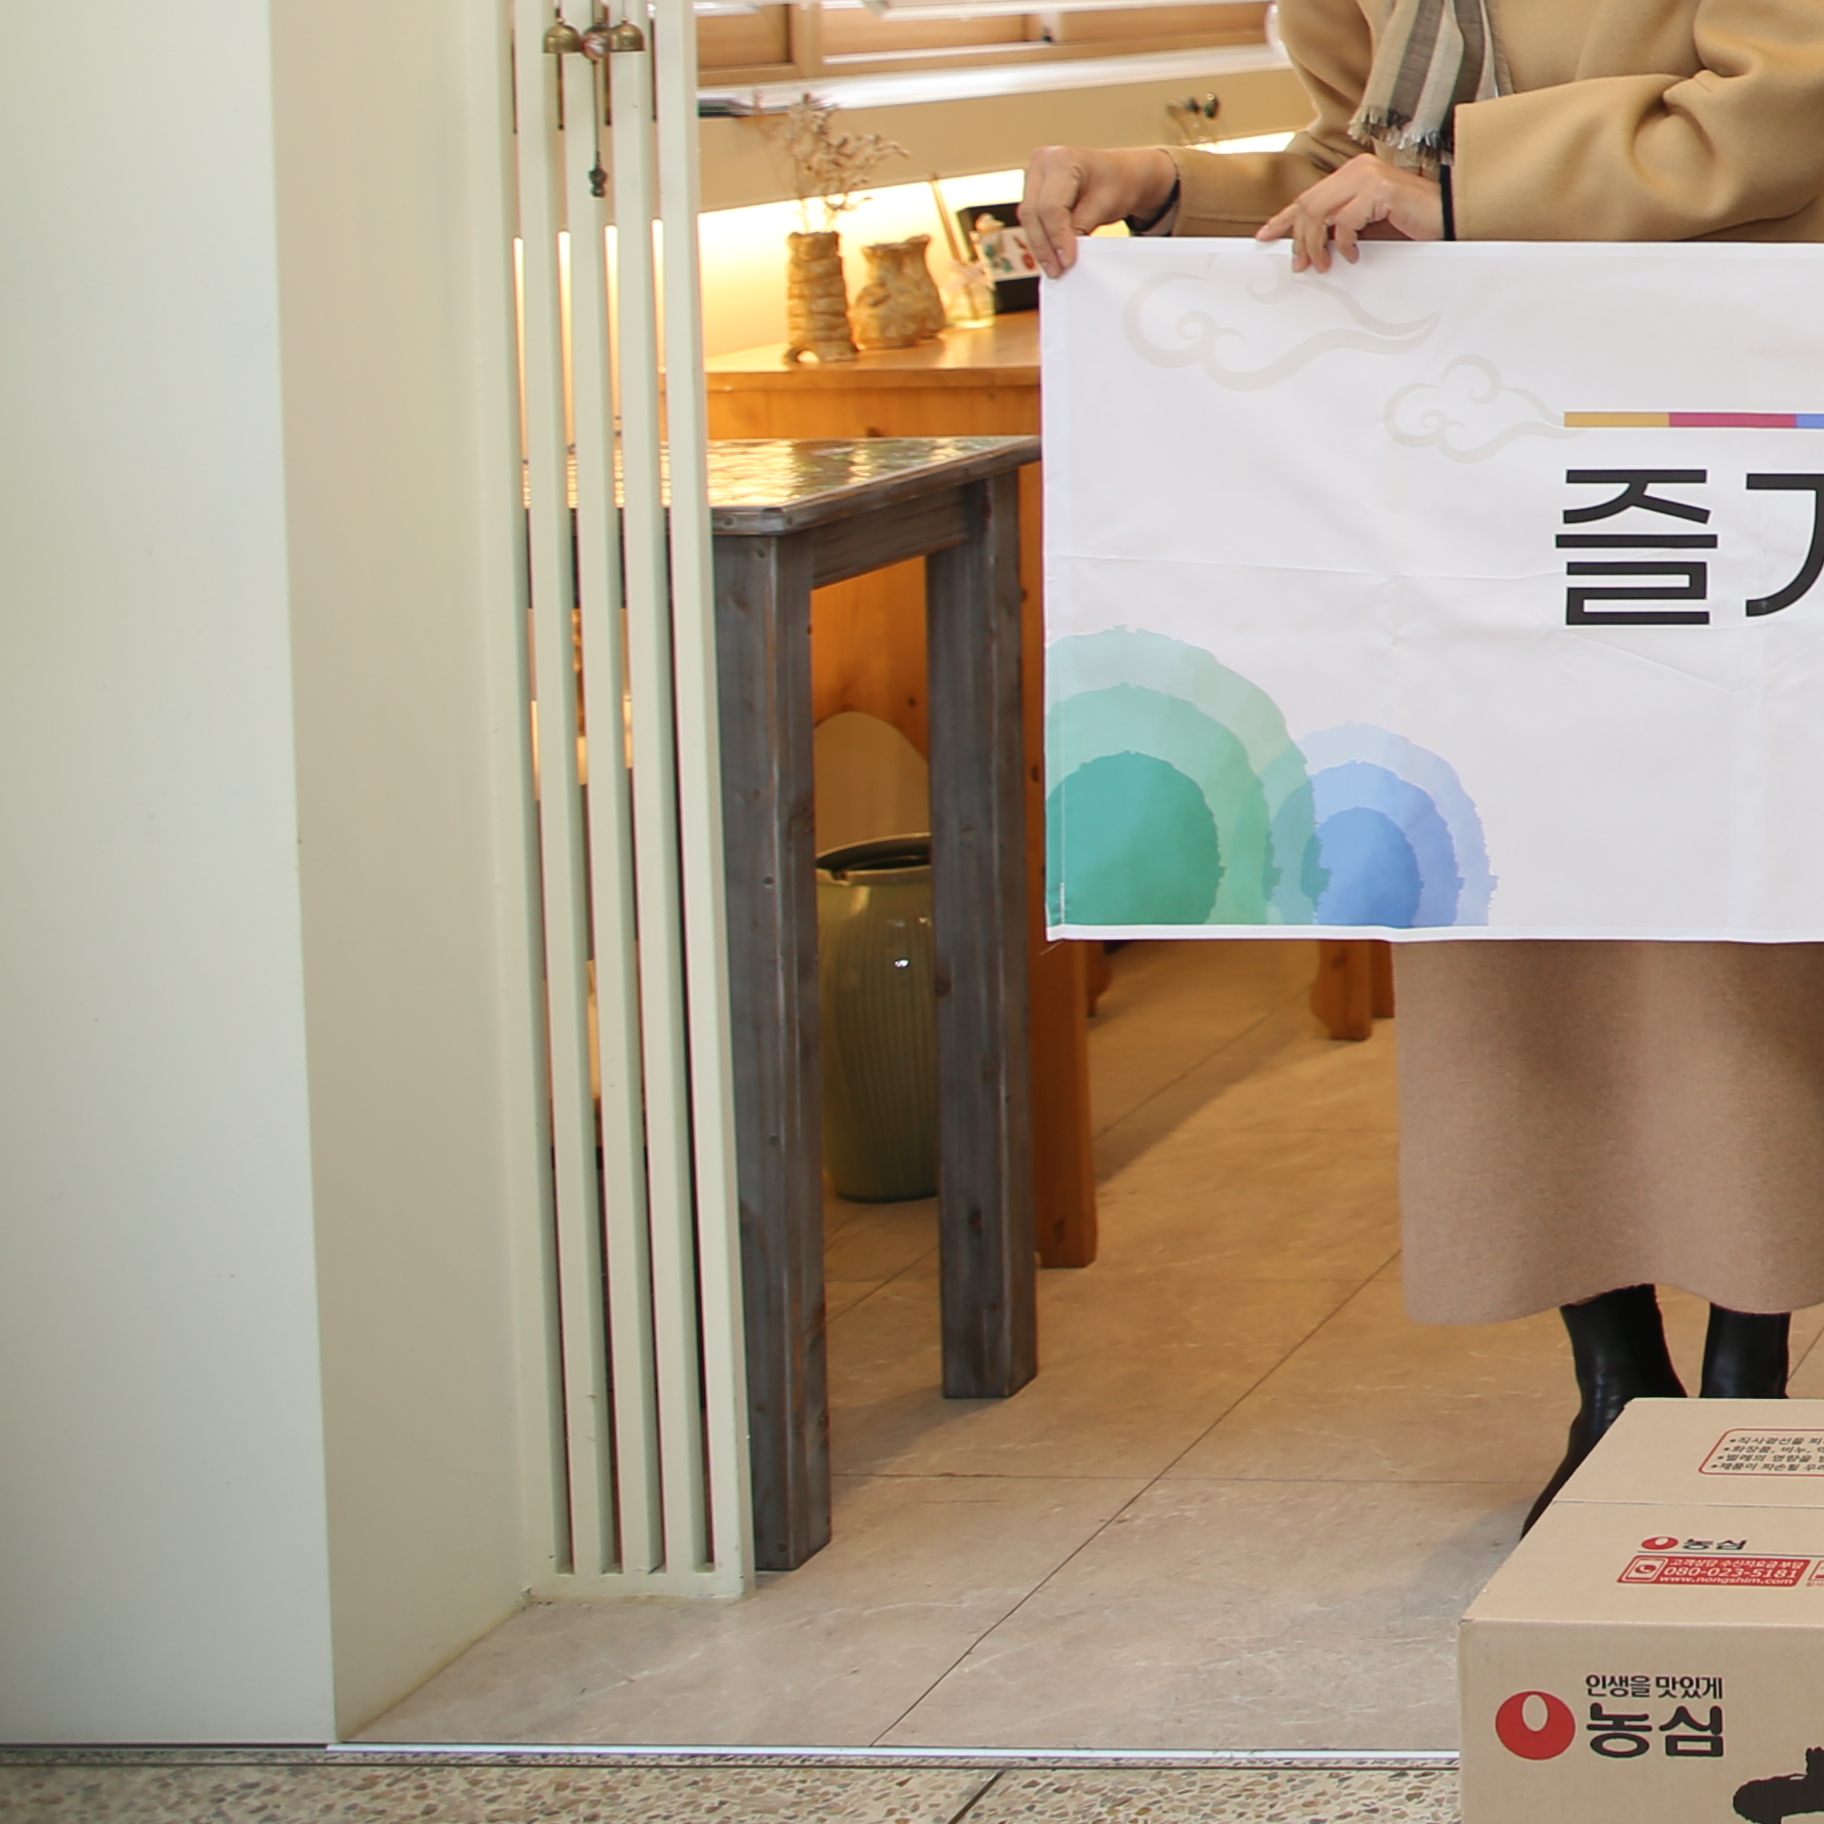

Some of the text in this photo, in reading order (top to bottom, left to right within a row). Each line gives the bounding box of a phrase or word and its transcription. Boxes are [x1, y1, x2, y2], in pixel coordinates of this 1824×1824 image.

[1682, 1537, 1749, 1552] 농심
[1663, 1566, 1798, 1579] 080-023-5181
[1658, 1575, 1795, 1586] www.nongshim.com
[1585, 1674, 1723, 1701] 인생을 맛있게
[1586, 1701, 1725, 1759] 농심
